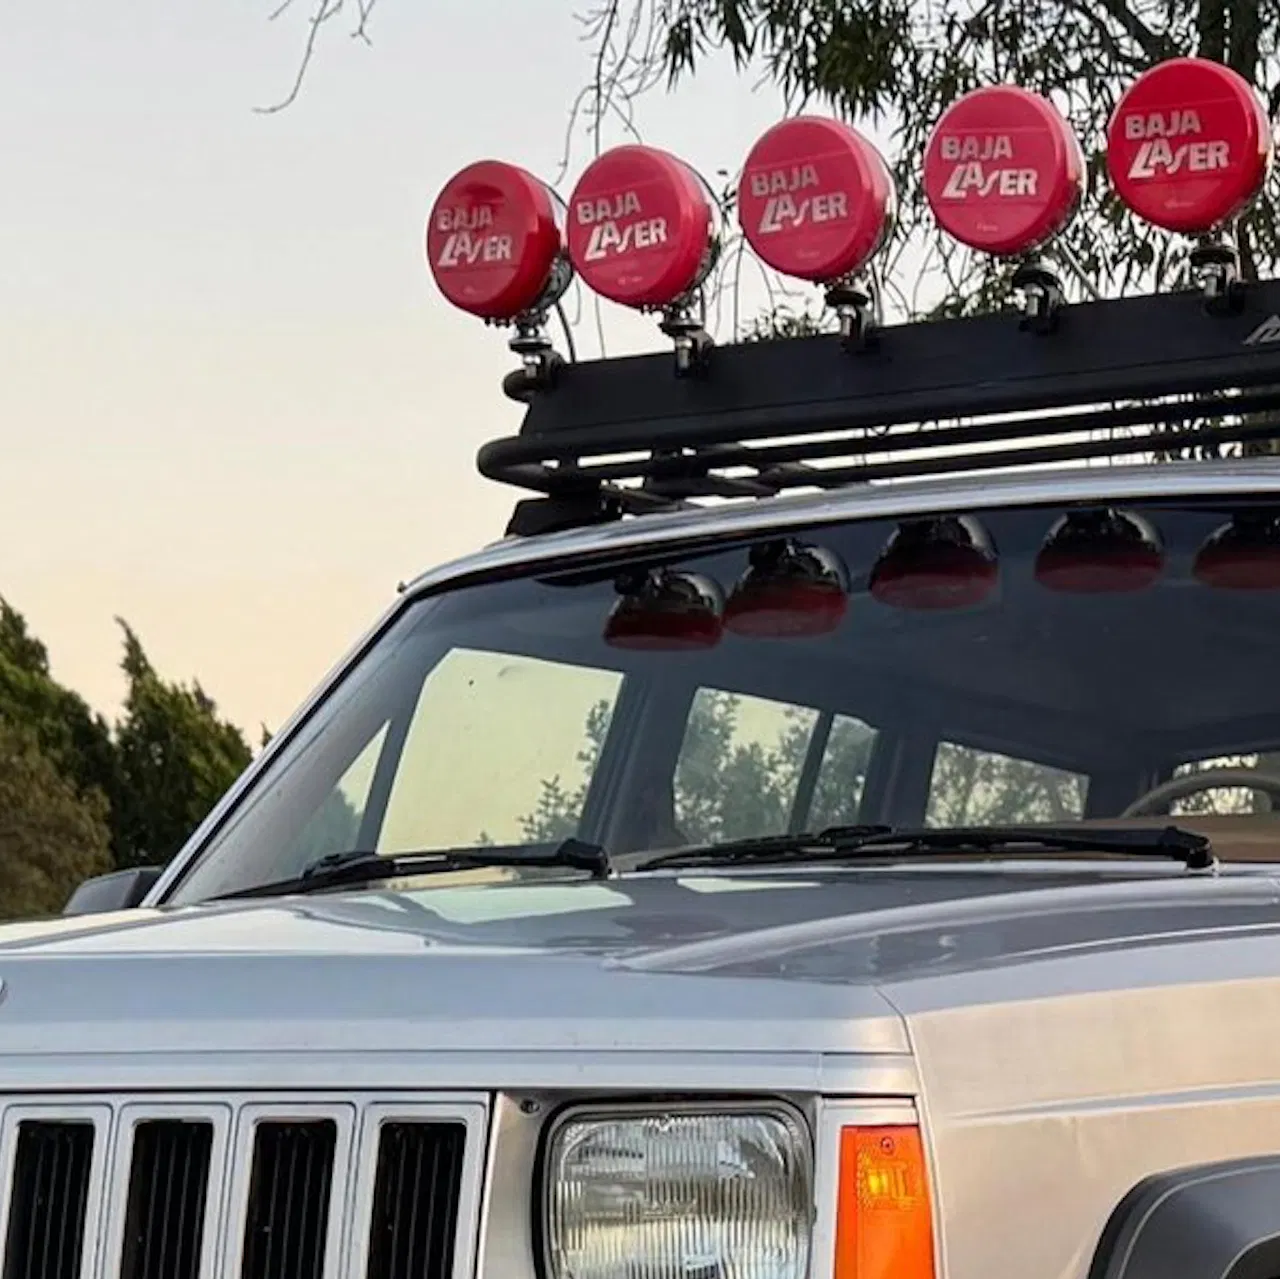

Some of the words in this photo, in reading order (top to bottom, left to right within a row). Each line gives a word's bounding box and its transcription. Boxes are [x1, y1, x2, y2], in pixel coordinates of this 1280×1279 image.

[1125, 108, 1201, 140] BAJA
[941, 135, 1012, 161] BAJA
[1128, 140, 1230, 180] LASER
[751, 164, 820, 198] BAJA
[942, 167, 1038, 198] LASER
[436, 204, 494, 231] BAJA
[577, 191, 642, 225] BAJA
[758, 192, 847, 234] LASER
[437, 232, 513, 267] LASER
[584, 217, 667, 262] LASER
